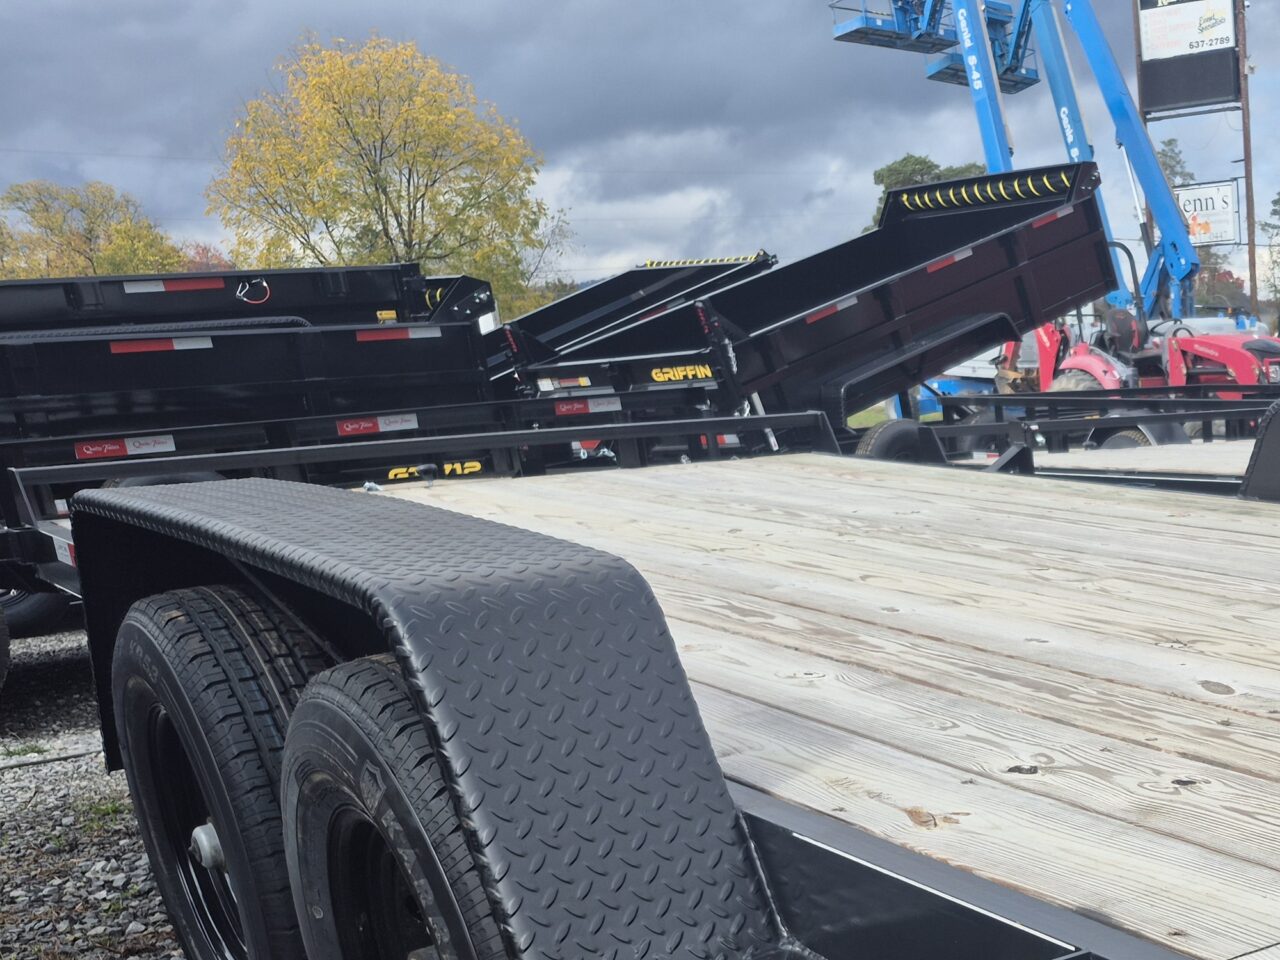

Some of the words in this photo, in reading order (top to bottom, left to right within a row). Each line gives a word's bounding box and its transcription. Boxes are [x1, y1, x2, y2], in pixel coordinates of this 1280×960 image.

[1060, 107, 1074, 145] Genie
[1175, 187, 1229, 213] enn's
[651, 364, 713, 382] GRIFFIN
